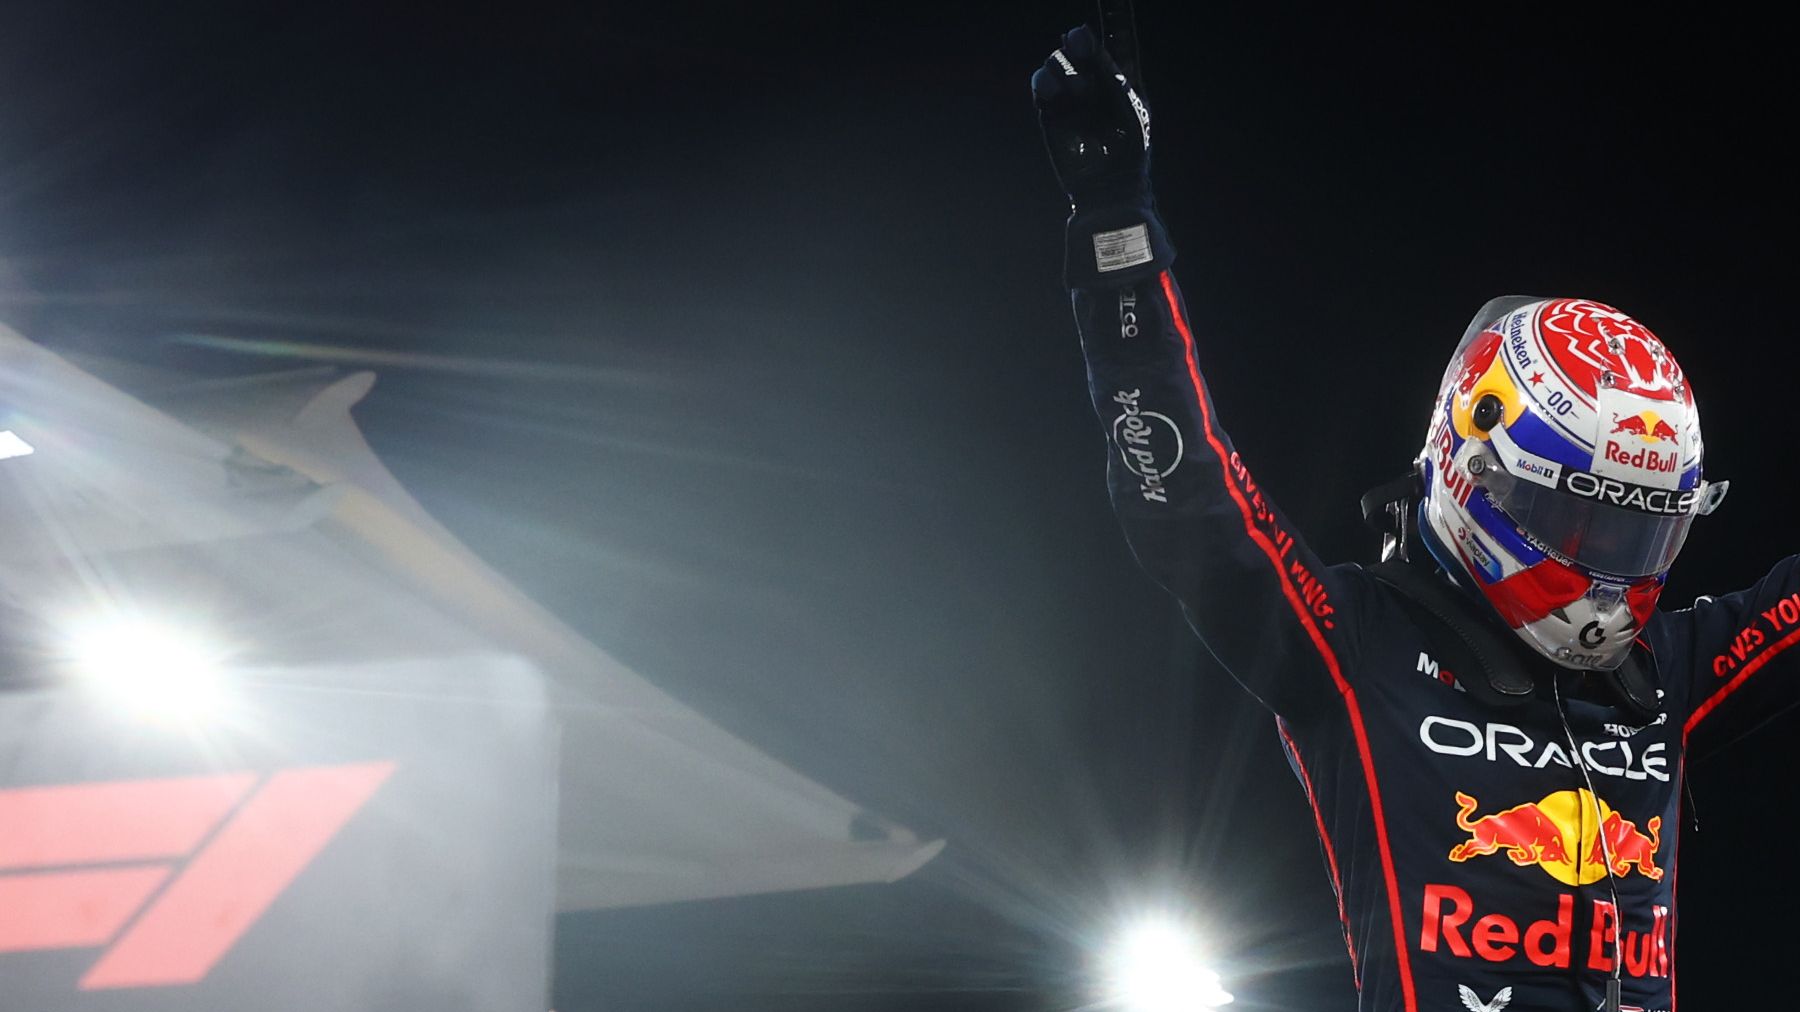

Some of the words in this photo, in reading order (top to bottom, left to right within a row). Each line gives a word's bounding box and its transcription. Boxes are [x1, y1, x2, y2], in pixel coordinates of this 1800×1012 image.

[1511, 311, 1532, 370] Heineken
[1113, 388, 1152, 446] Rock
[1128, 446, 1167, 503] Hard
[1439, 430, 1474, 508] Bull
[1516, 458, 1543, 476] Mobil
[1605, 440, 1646, 469] Red
[1646, 450, 1678, 473] Bull
[1566, 471, 1697, 514] ORACLE
[1419, 715, 1670, 782] ORACLE
[1420, 883, 1574, 969] Red
[1587, 899, 1669, 979] Bull
